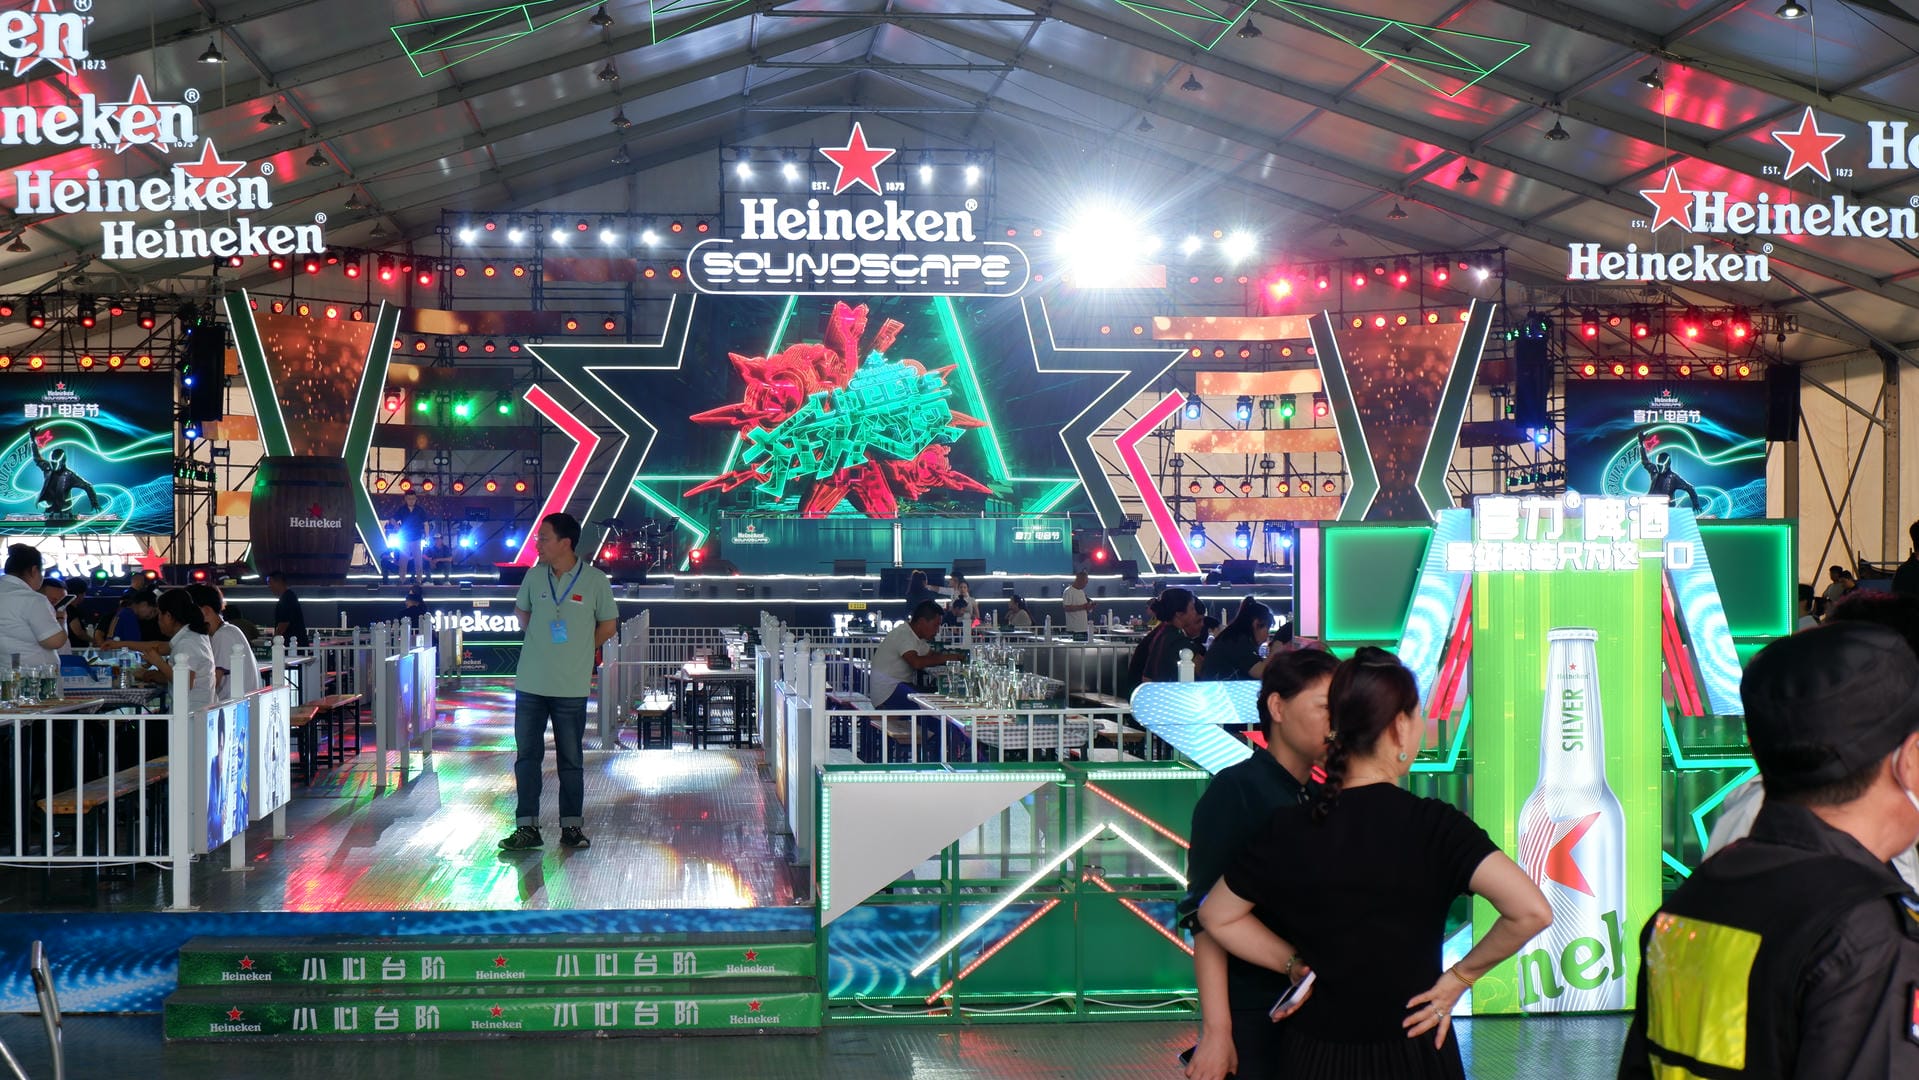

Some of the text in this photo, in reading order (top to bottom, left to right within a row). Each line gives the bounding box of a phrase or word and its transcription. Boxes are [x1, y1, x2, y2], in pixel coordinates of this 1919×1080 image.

[82, 60, 106, 70] 1873
[1763, 165, 1853, 177] EST. 1873
[812, 182, 905, 191] EST. 1873
[1631, 219, 1648, 229] EST.
[289, 517, 342, 528] Heineken
[1562, 688, 1584, 751] SILVER
[222, 952, 775, 981] Heineken 小心台阶 Heineken 小心台阶 Heineken
[210, 1001, 780, 1032] Heineken 小心台阶 Heineken 小心台阶 Heineken
